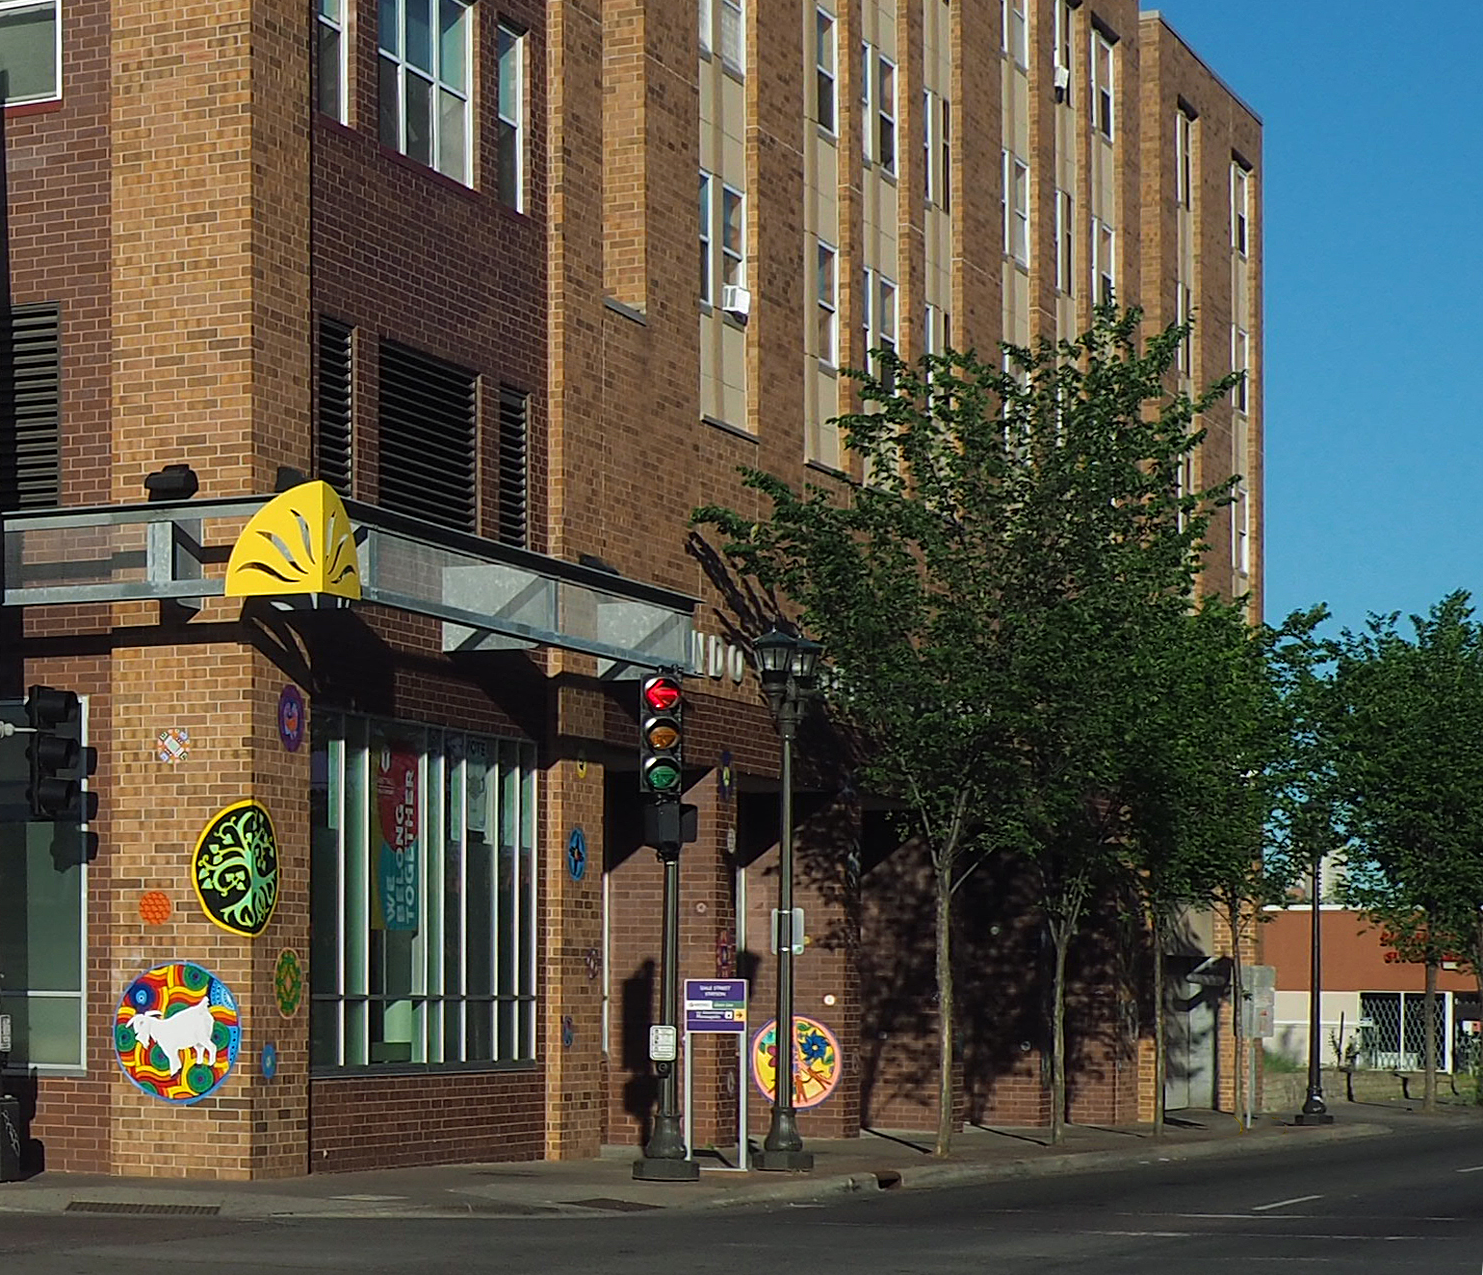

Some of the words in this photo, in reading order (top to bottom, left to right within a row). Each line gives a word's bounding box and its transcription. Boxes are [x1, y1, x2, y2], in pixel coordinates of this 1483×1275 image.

[387, 876, 396, 922] WE
[395, 804, 404, 923] BELONG
[405, 769, 414, 924] TOGETHER
